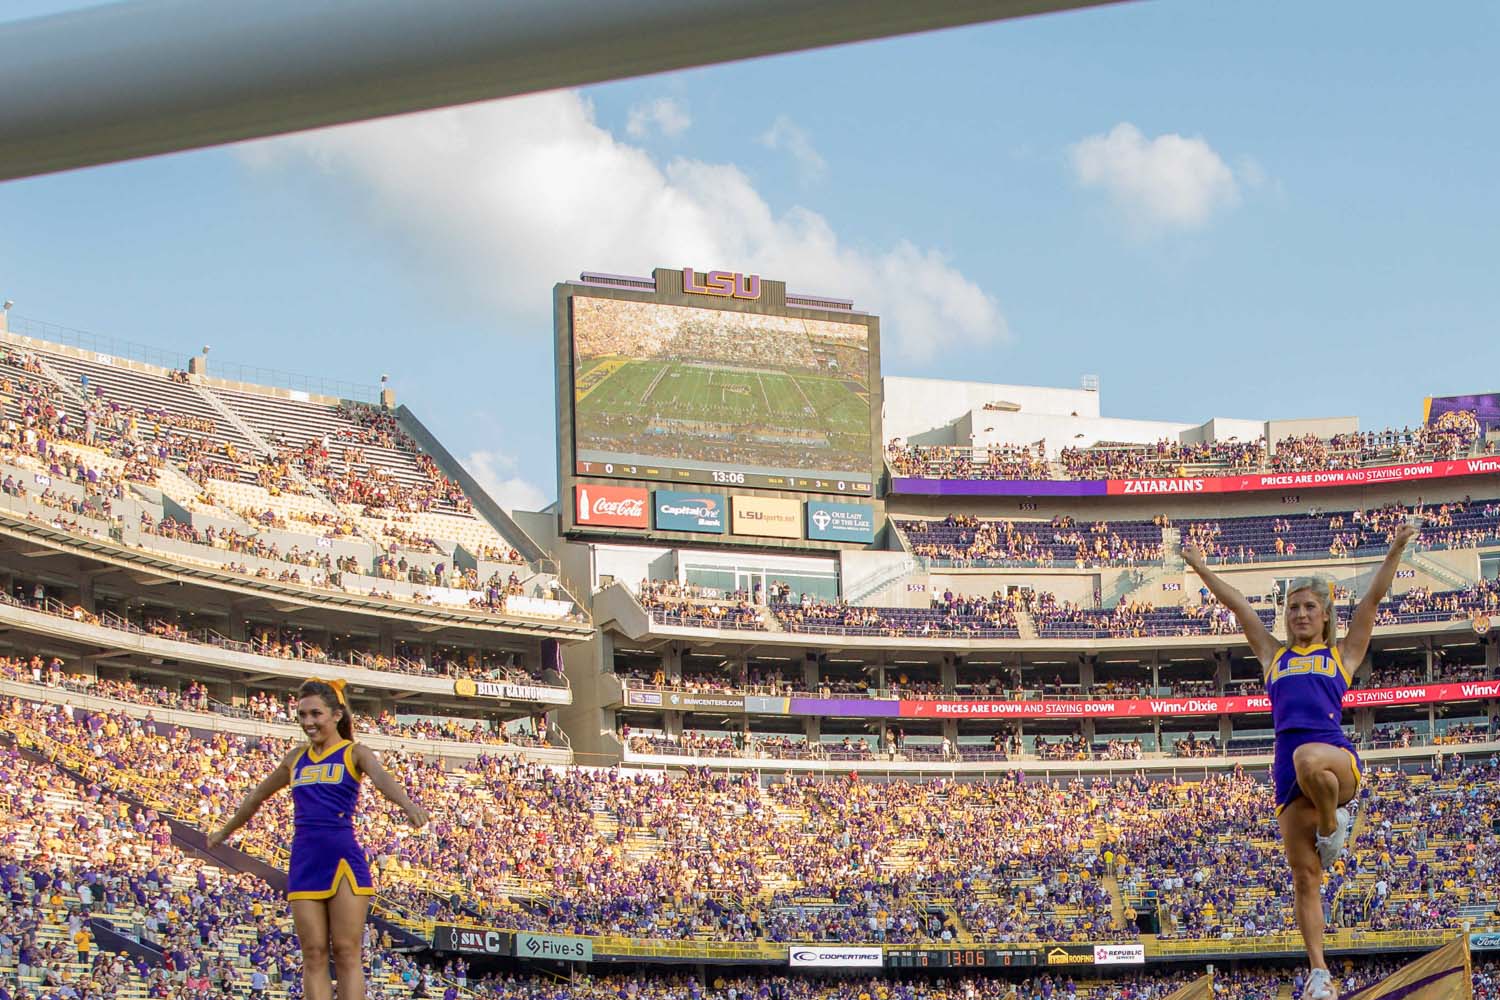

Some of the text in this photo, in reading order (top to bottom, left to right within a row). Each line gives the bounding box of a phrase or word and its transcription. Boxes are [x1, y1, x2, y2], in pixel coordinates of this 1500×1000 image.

[683, 267, 761, 299] LSU
[605, 464, 613, 474] 0
[712, 471, 745, 483] 13:06
[1261, 466, 1432, 485] PRICES ARE DOWN AND STAYING DOWN
[838, 482, 845, 490] 0
[852, 483, 870, 491] LSU
[1124, 479, 1204, 493] ZATARAIN'S
[698, 518, 720, 527] Bank
[1271, 654, 1337, 684] LSU
[1357, 689, 1425, 702] STAYING DOWN
[936, 703, 1114, 713] PRICES ARE DOWN AND STAYING DOWN
[291, 763, 344, 787] LSU
[1477, 936, 1500, 947] Ford
[542, 941, 584, 956] Five-S
[922, 957, 927, 966] 0
[947, 952, 985, 967] 13:06
[1004, 954, 1009, 965] 0
[1069, 955, 1094, 963] ROOFING
